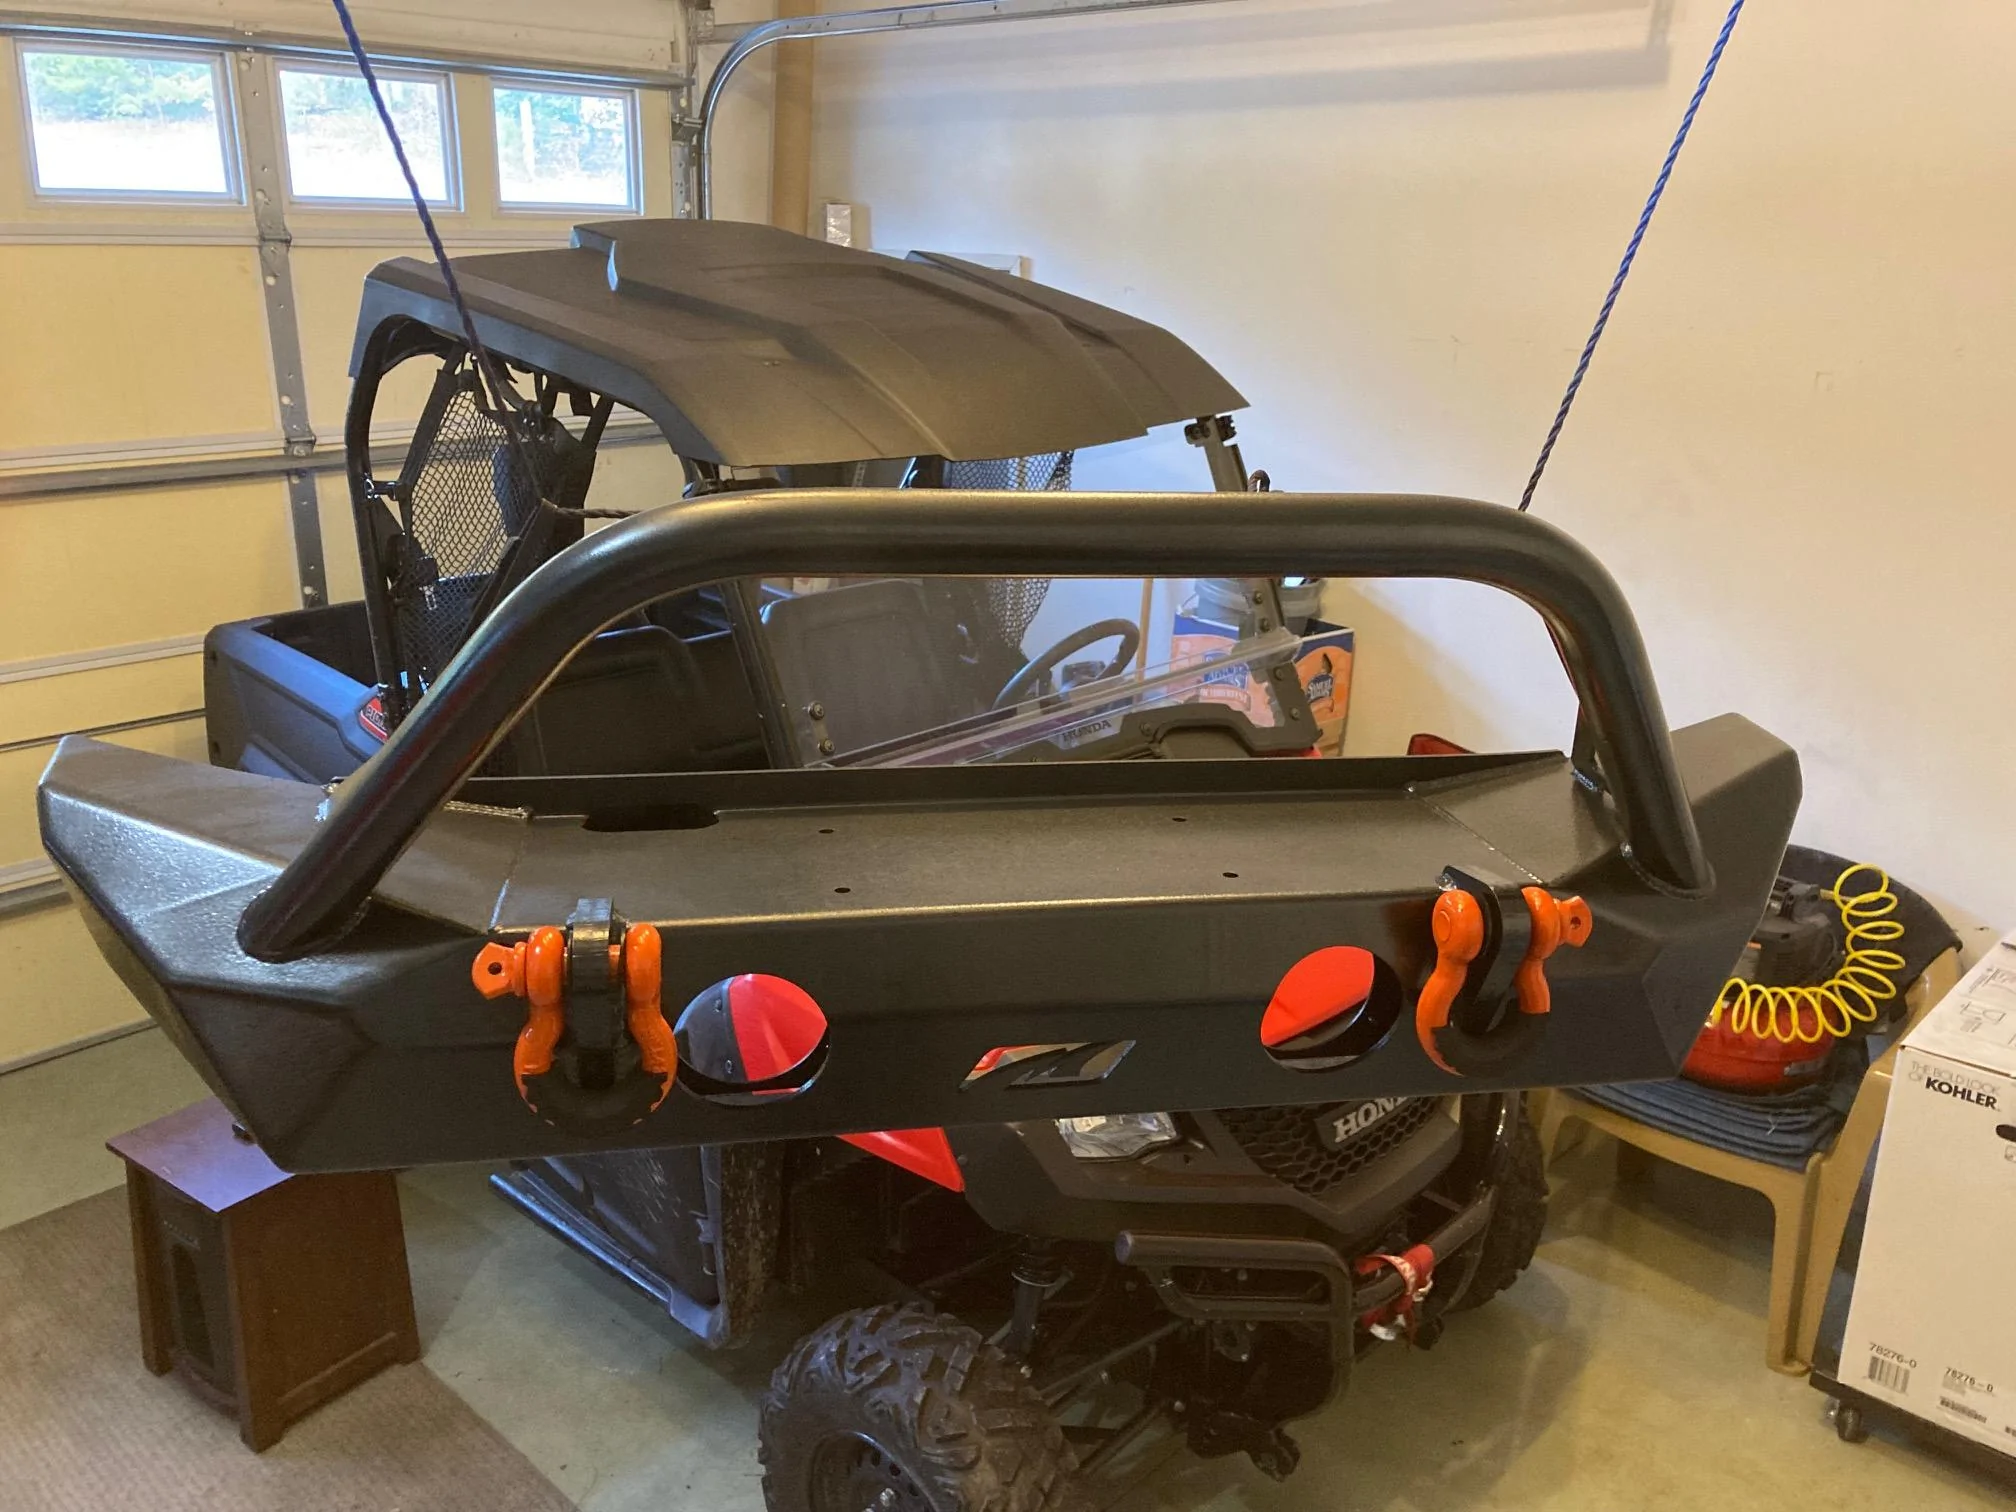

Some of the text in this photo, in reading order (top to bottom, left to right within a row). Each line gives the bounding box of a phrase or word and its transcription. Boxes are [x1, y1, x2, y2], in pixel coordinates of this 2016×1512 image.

[1062, 719, 1113, 743] HONDA
[1911, 1060, 1932, 1075] THE
[1932, 1068, 1964, 1085] BOLD
[1925, 1076, 1998, 1110] KOHLER
[1868, 1341, 1918, 1369] 78276-0
